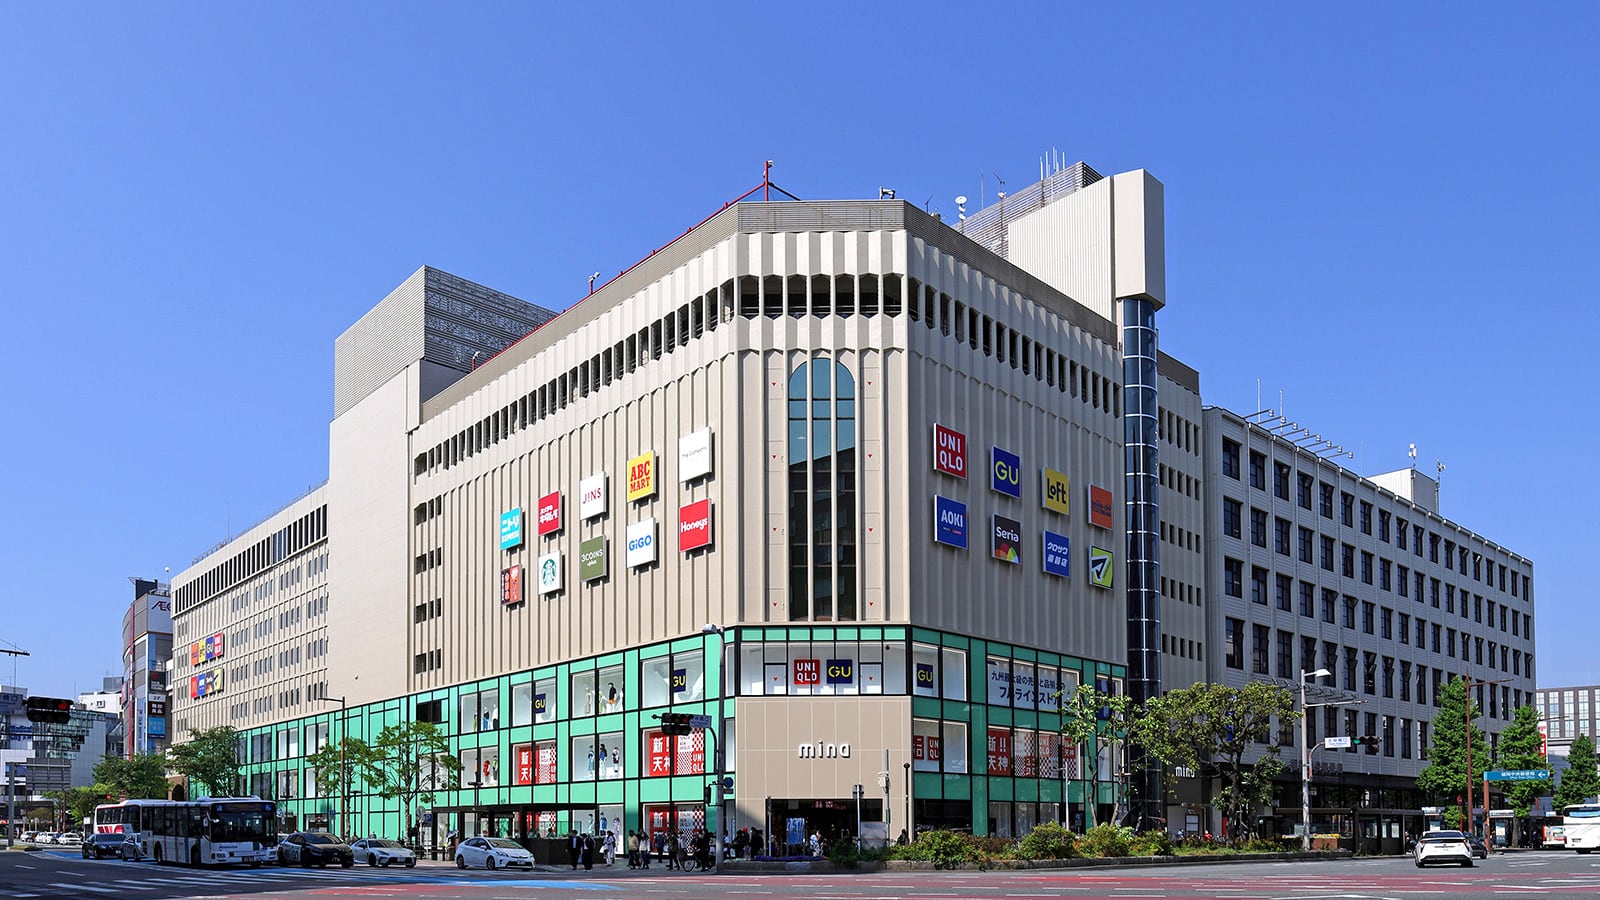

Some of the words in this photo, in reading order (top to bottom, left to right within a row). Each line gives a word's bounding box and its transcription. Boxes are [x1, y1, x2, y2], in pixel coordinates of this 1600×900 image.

[939, 431, 961, 453] UNI
[939, 451, 963, 472] QLO
[630, 461, 650, 482] ABC
[995, 460, 1019, 485] GU
[630, 477, 650, 493] MART
[502, 514, 519, 533] ニトリ
[680, 517, 708, 533] Honeys
[941, 509, 963, 528] AOKI
[996, 525, 1019, 542] Seria
[628, 534, 652, 551] GiGO
[1047, 542, 1068, 555] クロサワ
[581, 548, 603, 562] 3COINS
[797, 662, 815, 671] UNI
[828, 665, 851, 678] GU
[673, 675, 686, 687] GU
[797, 672, 817, 683] QLO
[917, 669, 933, 682] GU
[535, 699, 546, 709] GU
[799, 740, 851, 759] mina
[930, 739, 939, 748] UN
[929, 749, 939, 760] QL
[988, 755, 1008, 771] 天神
